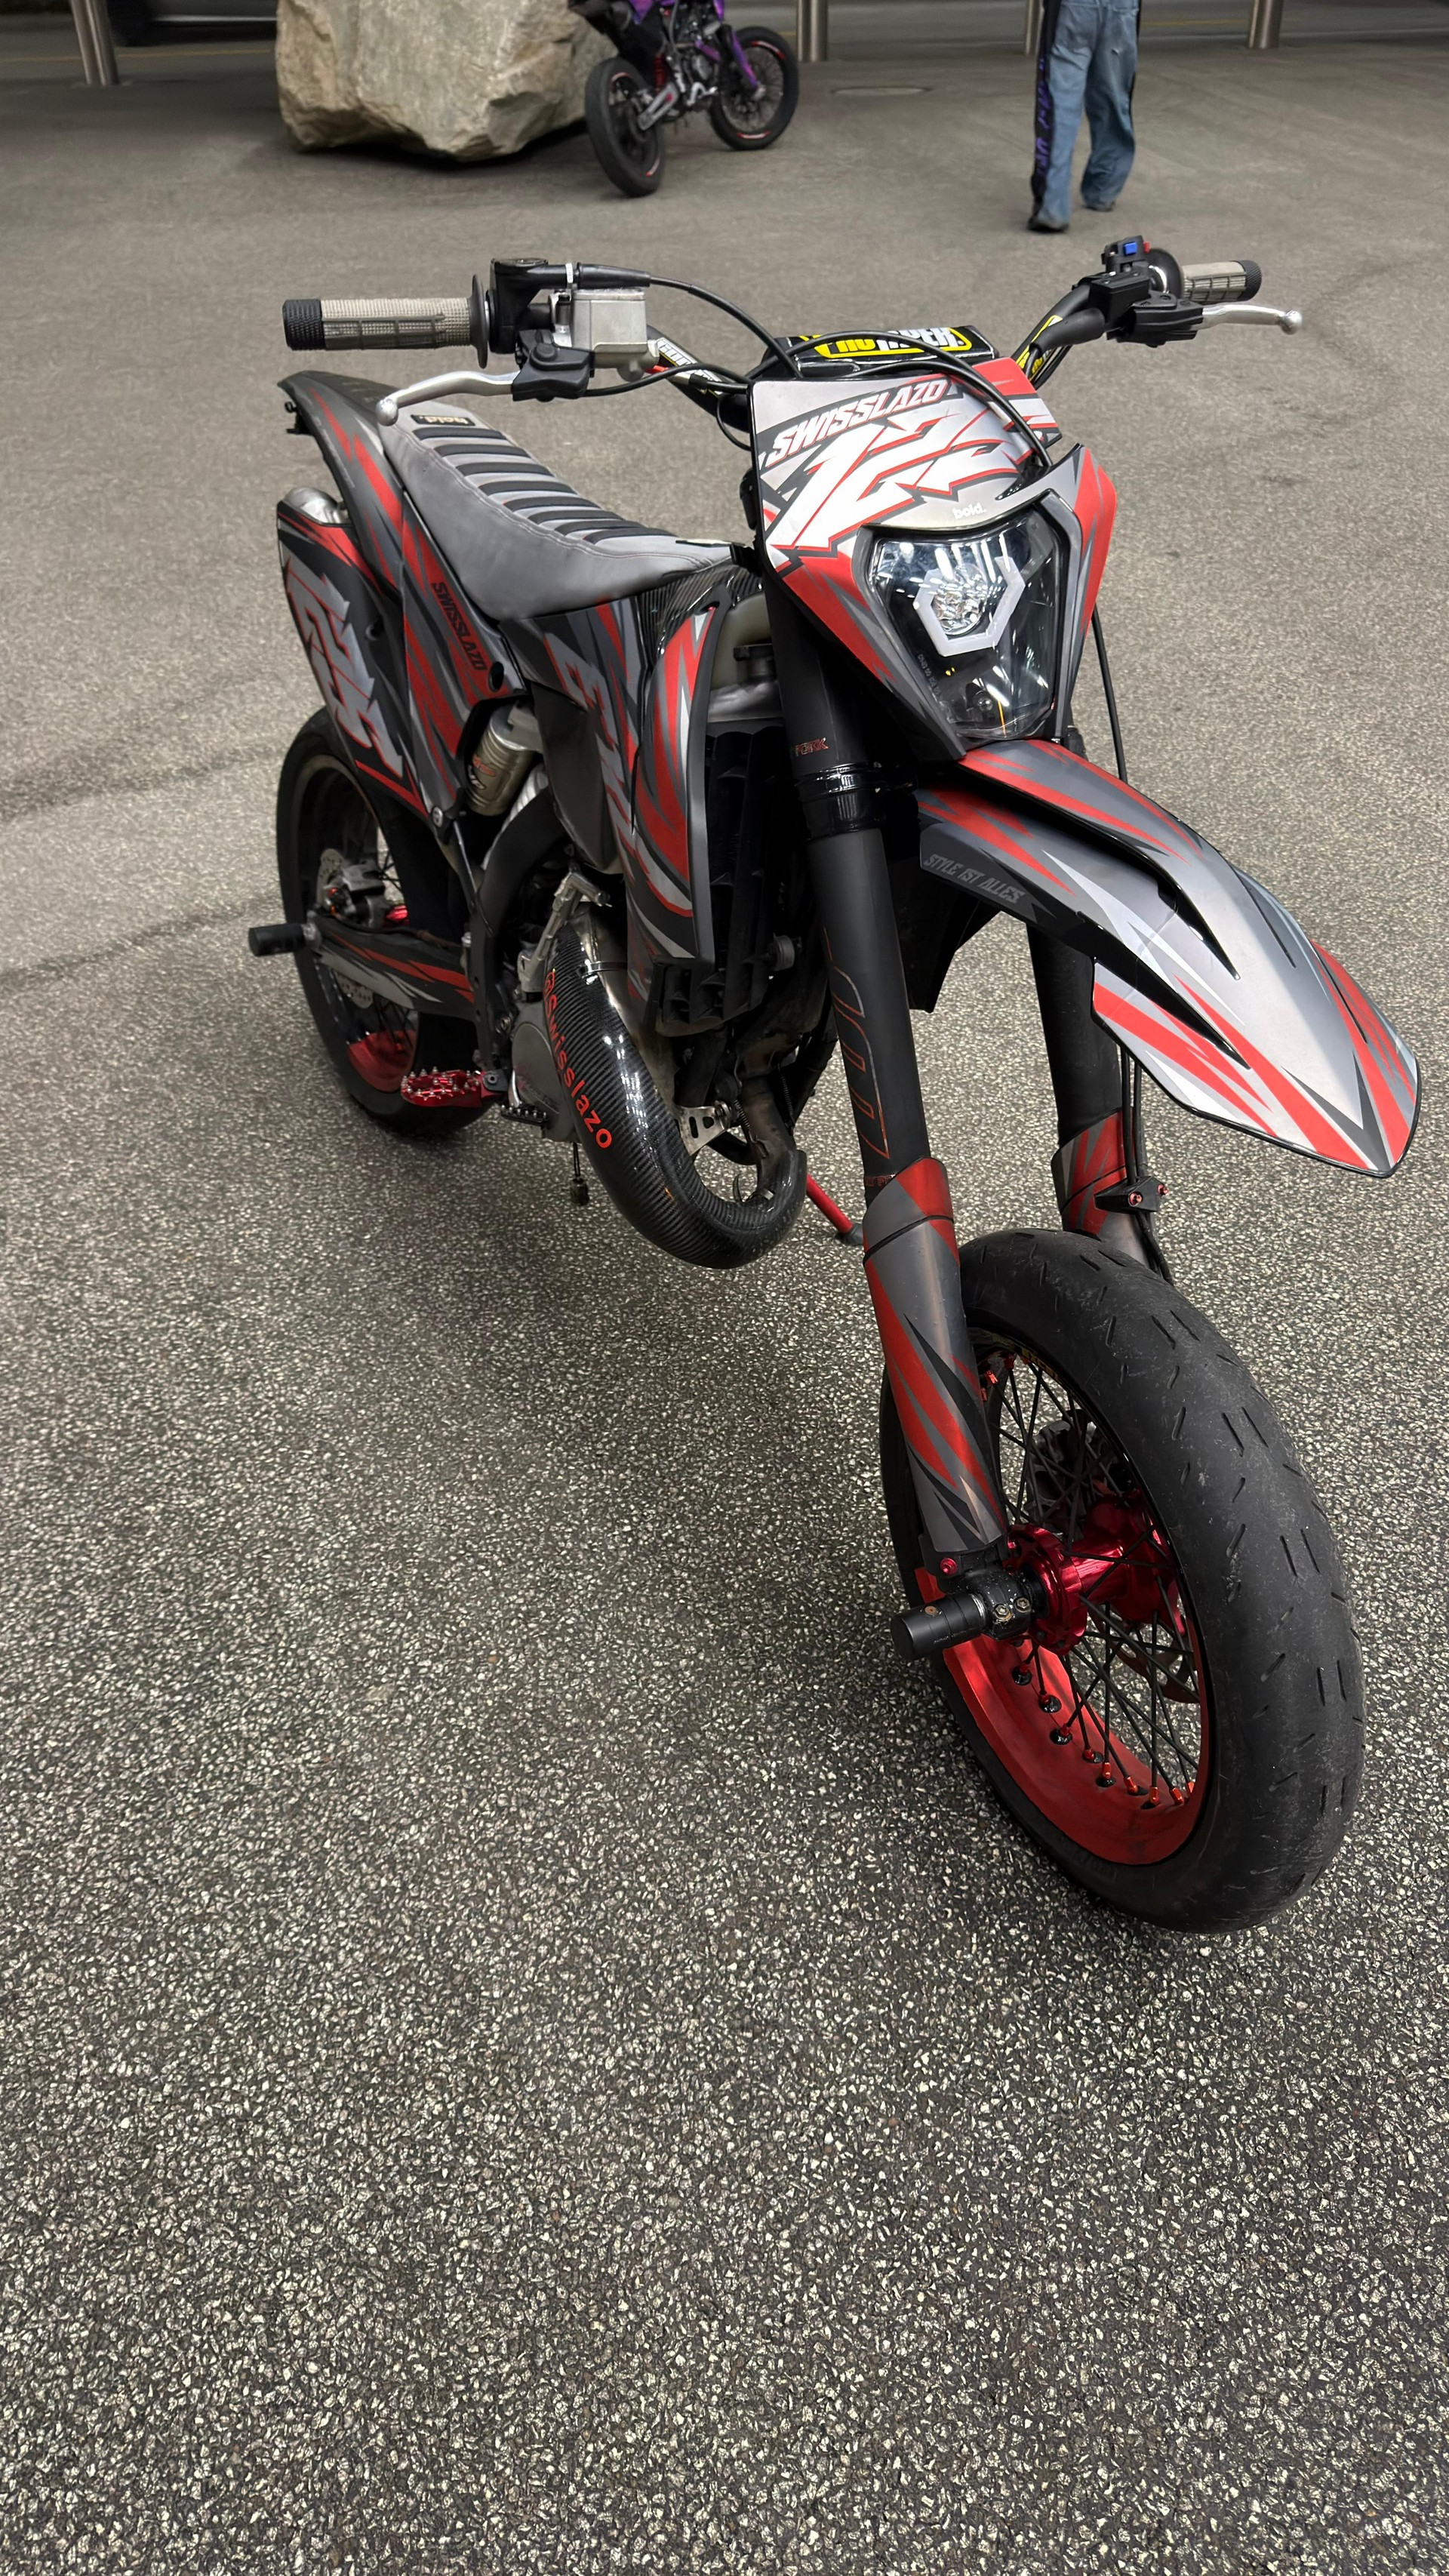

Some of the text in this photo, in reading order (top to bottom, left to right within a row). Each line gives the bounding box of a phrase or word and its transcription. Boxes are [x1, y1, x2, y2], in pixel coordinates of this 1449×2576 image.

[765, 379, 950, 468] SWISSLAZO
[952, 502, 987, 520] bold.
[431, 581, 488, 671] SWISSLAZO
[923, 853, 1026, 903] STYLE IST ALLES
